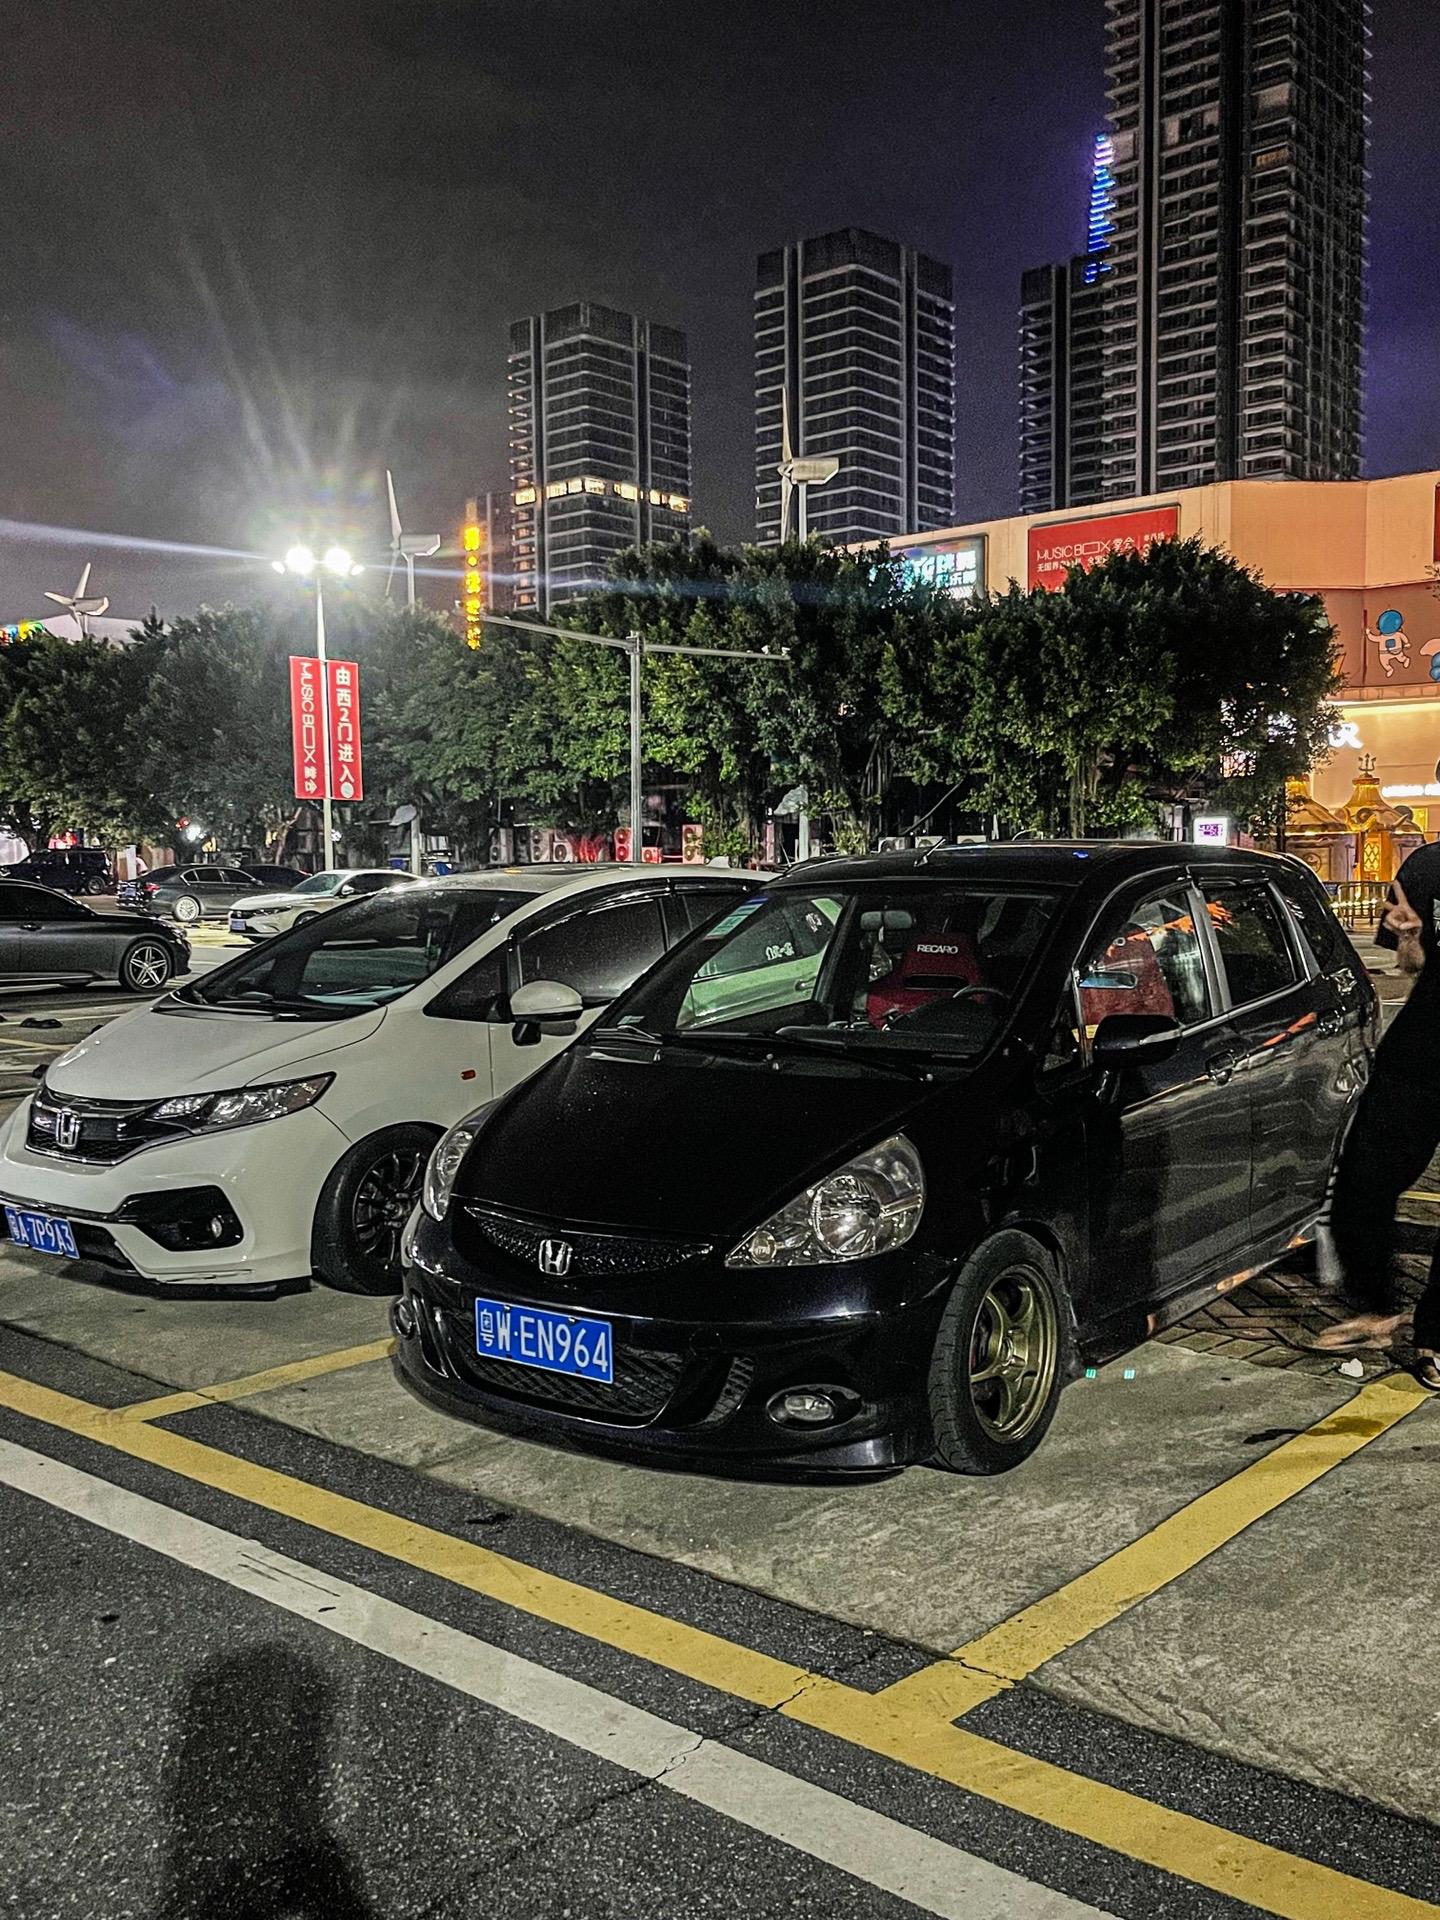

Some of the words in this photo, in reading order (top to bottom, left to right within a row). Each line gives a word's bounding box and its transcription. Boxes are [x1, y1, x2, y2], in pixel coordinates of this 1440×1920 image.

[1037, 545, 1073, 561] MUSIC
[300, 662, 315, 713] MUSIC
[335, 666, 355, 784] 由西2门进入
[917, 944, 958, 954] RECARO
